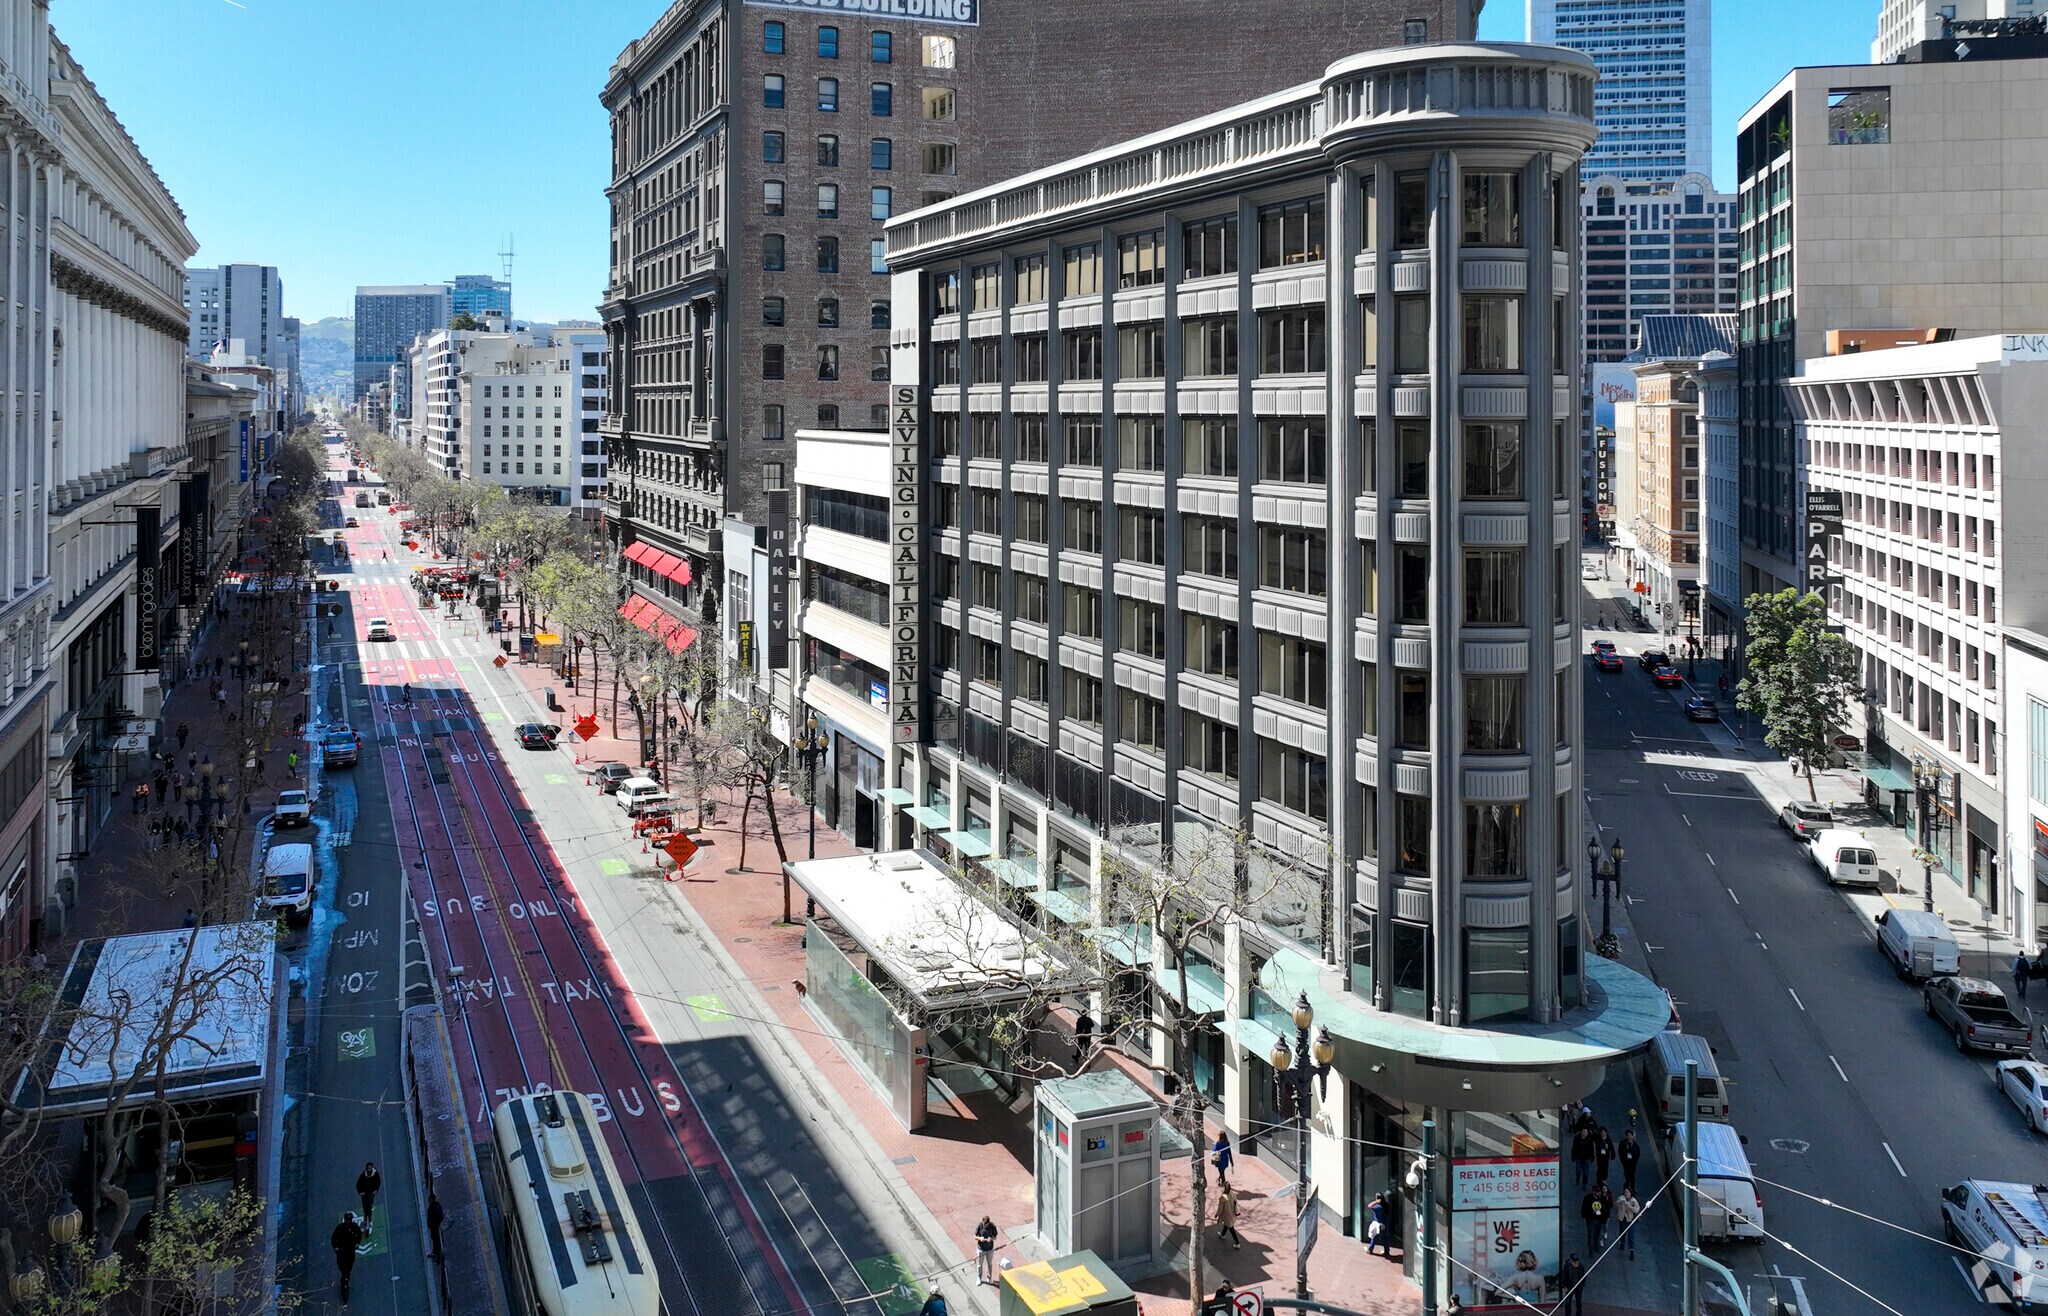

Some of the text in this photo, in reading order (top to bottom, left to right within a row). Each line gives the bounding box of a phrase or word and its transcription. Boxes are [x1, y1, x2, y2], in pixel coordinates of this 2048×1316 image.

[1601, 383, 1624, 396] New
[1606, 388, 1634, 404] Delhi
[1598, 440, 1608, 500] FUSION
[897, 388, 916, 721] SAVING CALIFORNIA
[772, 530, 784, 630] OAKLEY
[741, 632, 749, 670] Marten
[418, 672, 456, 680] ONLY
[450, 752, 497, 763] BUS
[1676, 770, 1719, 782] KEEP
[423, 895, 487, 917] BUS
[509, 897, 578, 919] ONLY
[333, 970, 379, 994] ZON
[541, 978, 614, 1004] TAXI
[586, 1082, 682, 1123] BUS
[1459, 1168, 1556, 1180] RETAIL FOR LEASE
[1473, 1182, 1493, 1193] 415
[1497, 1181, 1520, 1192] 658
[1524, 1180, 1556, 1191] 3600
[1493, 1220, 1520, 1235] WE
[1494, 1237, 1520, 1253] SF
